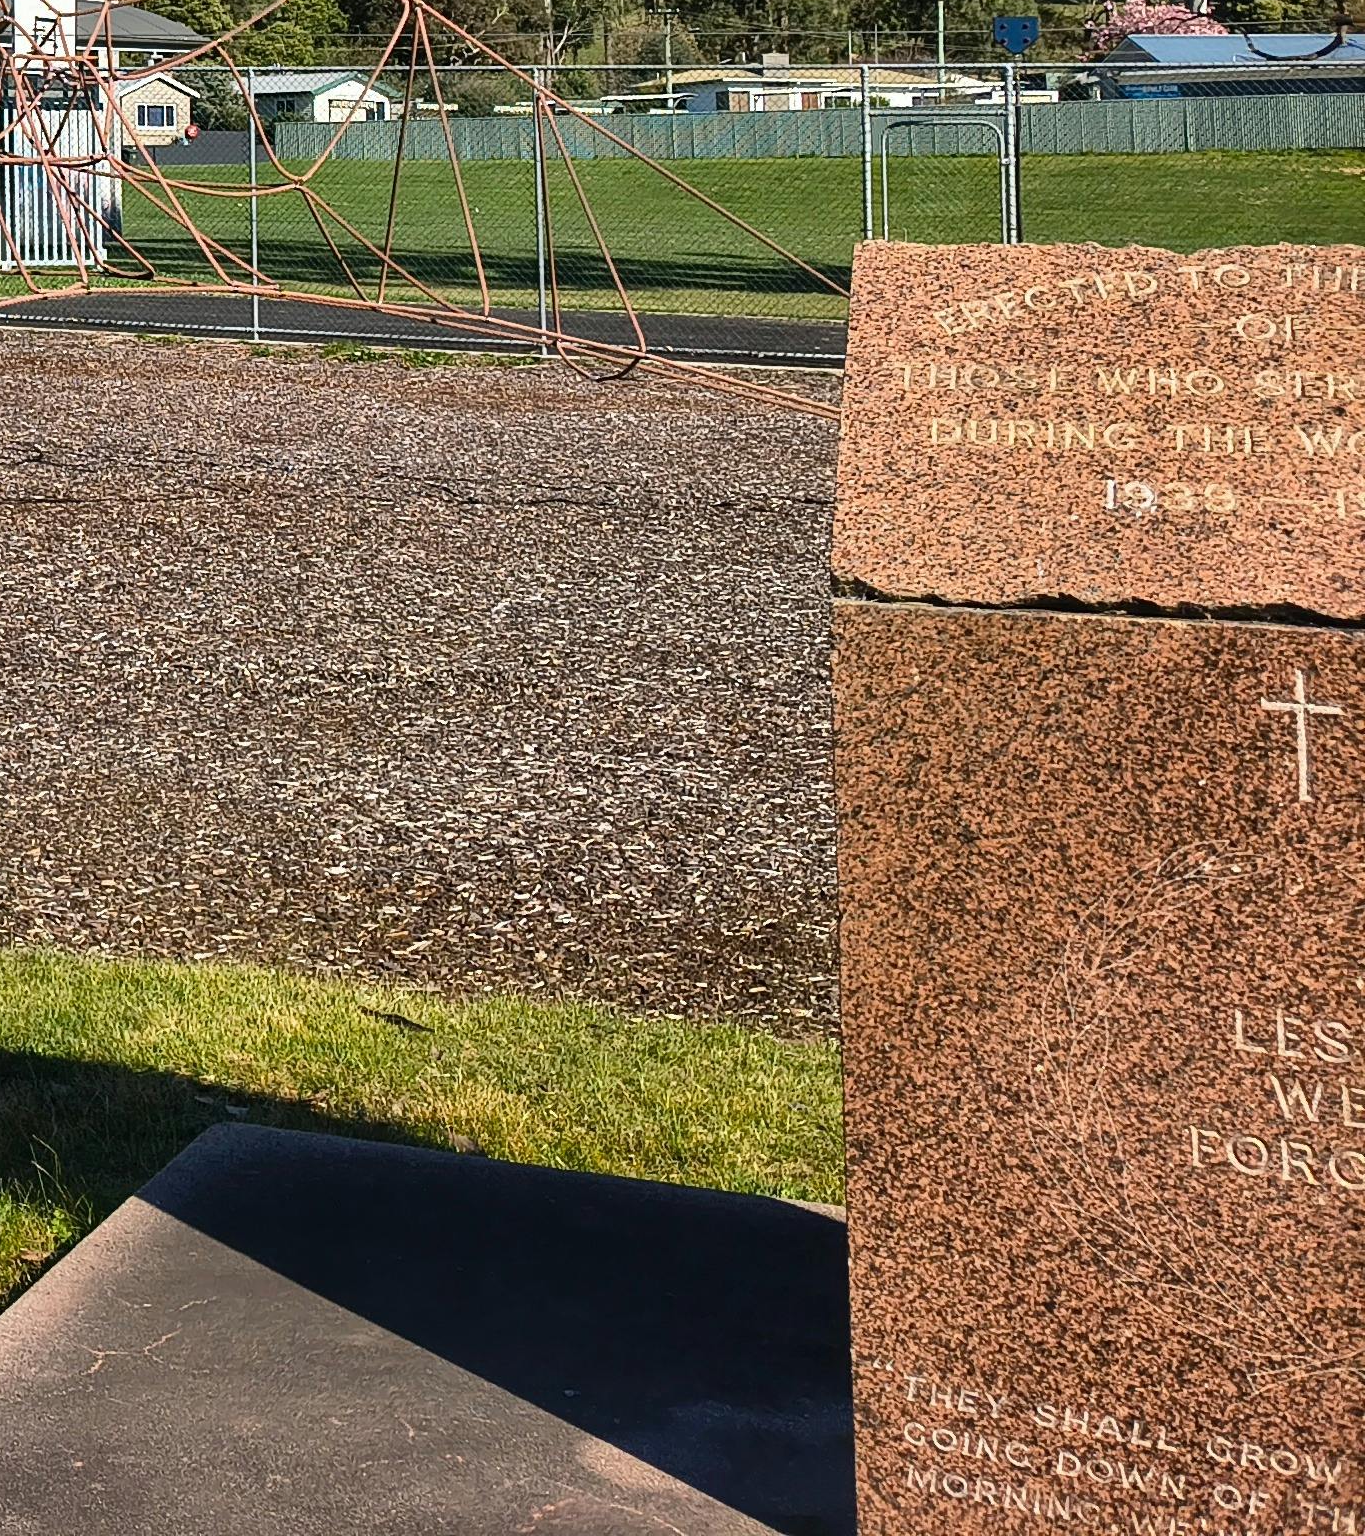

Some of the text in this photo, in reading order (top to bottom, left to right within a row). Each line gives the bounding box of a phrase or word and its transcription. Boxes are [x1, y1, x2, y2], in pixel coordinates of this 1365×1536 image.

[1177, 264, 1251, 291] TO
[1236, 313, 1307, 342] OF
[895, 363, 1080, 394] THOSE
[1096, 367, 1225, 398] WHO
[930, 417, 1137, 451] DURING
[1166, 424, 1270, 455] THE
[1034, 1404, 1178, 1453] SHALL
[1207, 1436, 1347, 1484] GROW
[904, 1422, 1033, 1468] GOING
[1055, 1450, 1186, 1500] DOWN
[1213, 1484, 1271, 1514] OF
